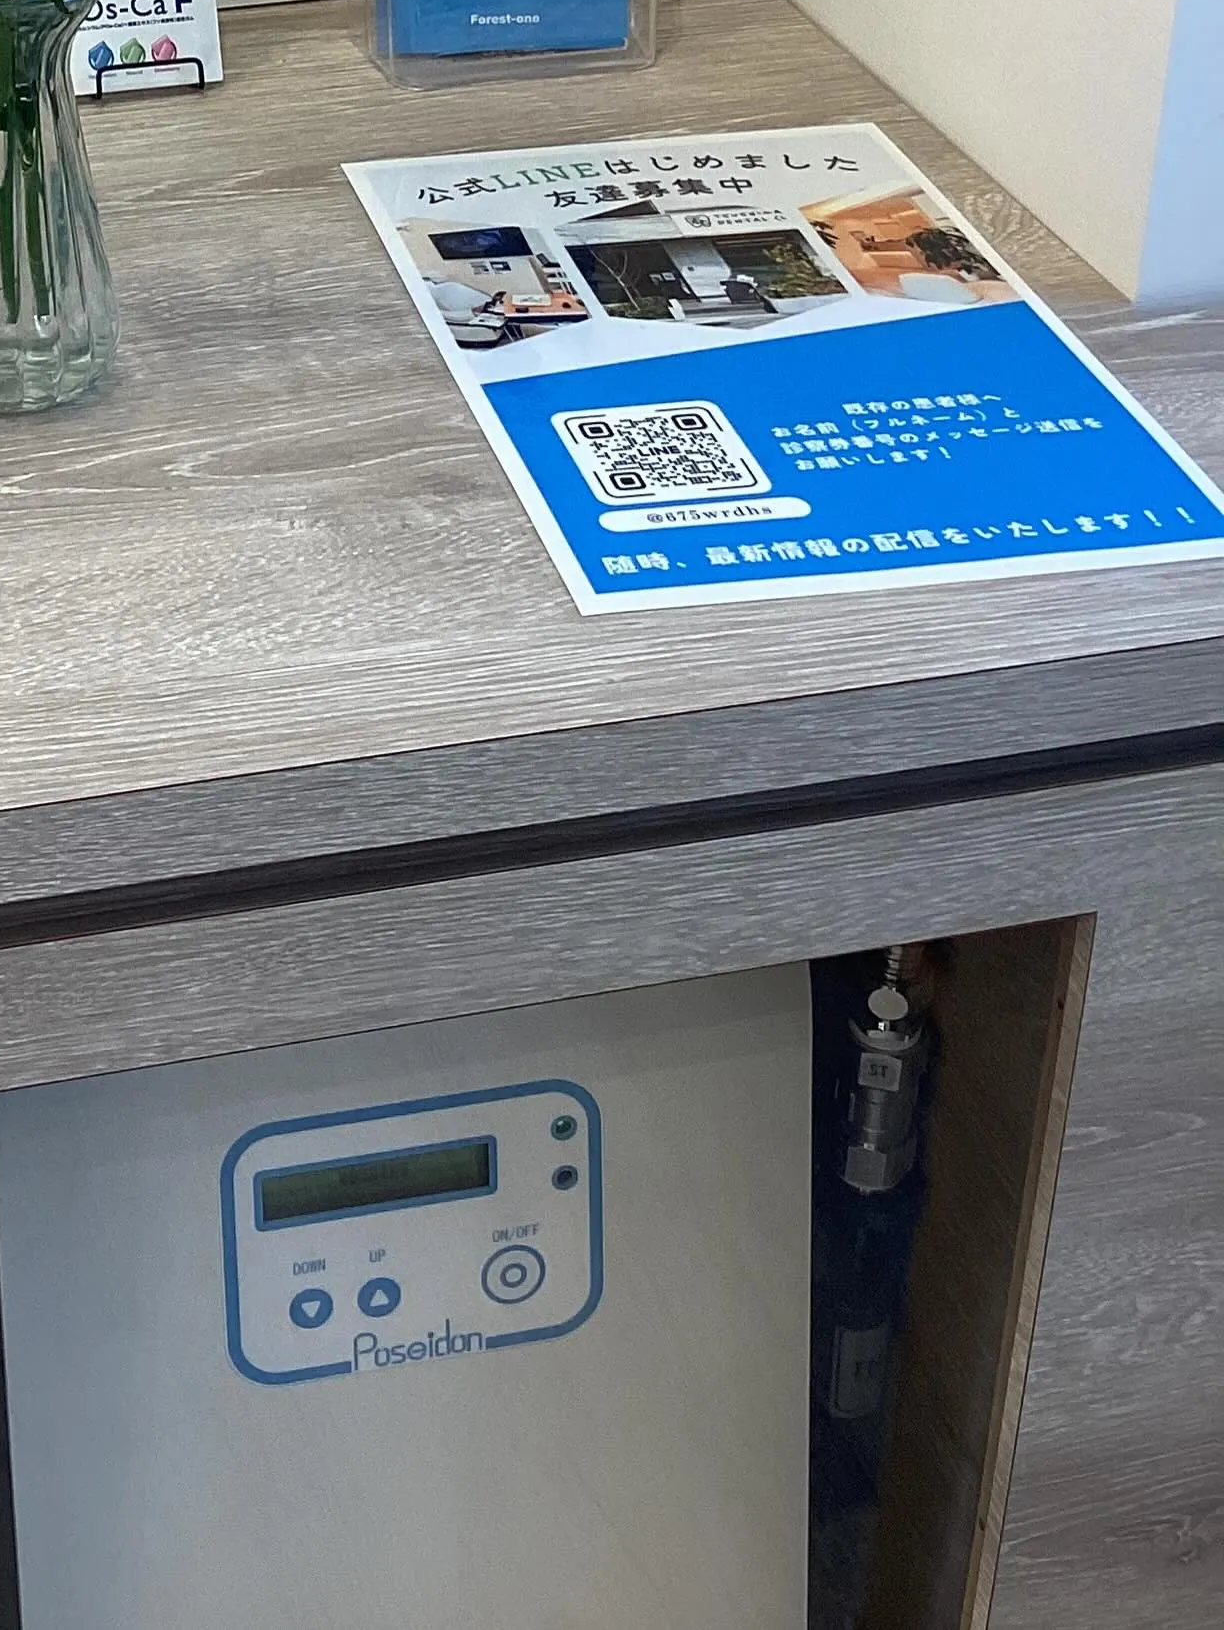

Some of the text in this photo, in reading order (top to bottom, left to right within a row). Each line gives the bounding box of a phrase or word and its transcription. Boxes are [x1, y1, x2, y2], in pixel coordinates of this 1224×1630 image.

[470, 13, 541, 26] Forest-one
[416, 151, 861, 208] 公式LINEはじめました
[543, 175, 756, 210] 友達募集中
[842, 392, 1002, 416] 既存の患者様へ
[638, 445, 681, 458] LINE
[368, 1221, 541, 1264] UP ON/OFF
[292, 1257, 327, 1276] DOWN
[352, 1318, 483, 1371] Poseidon
